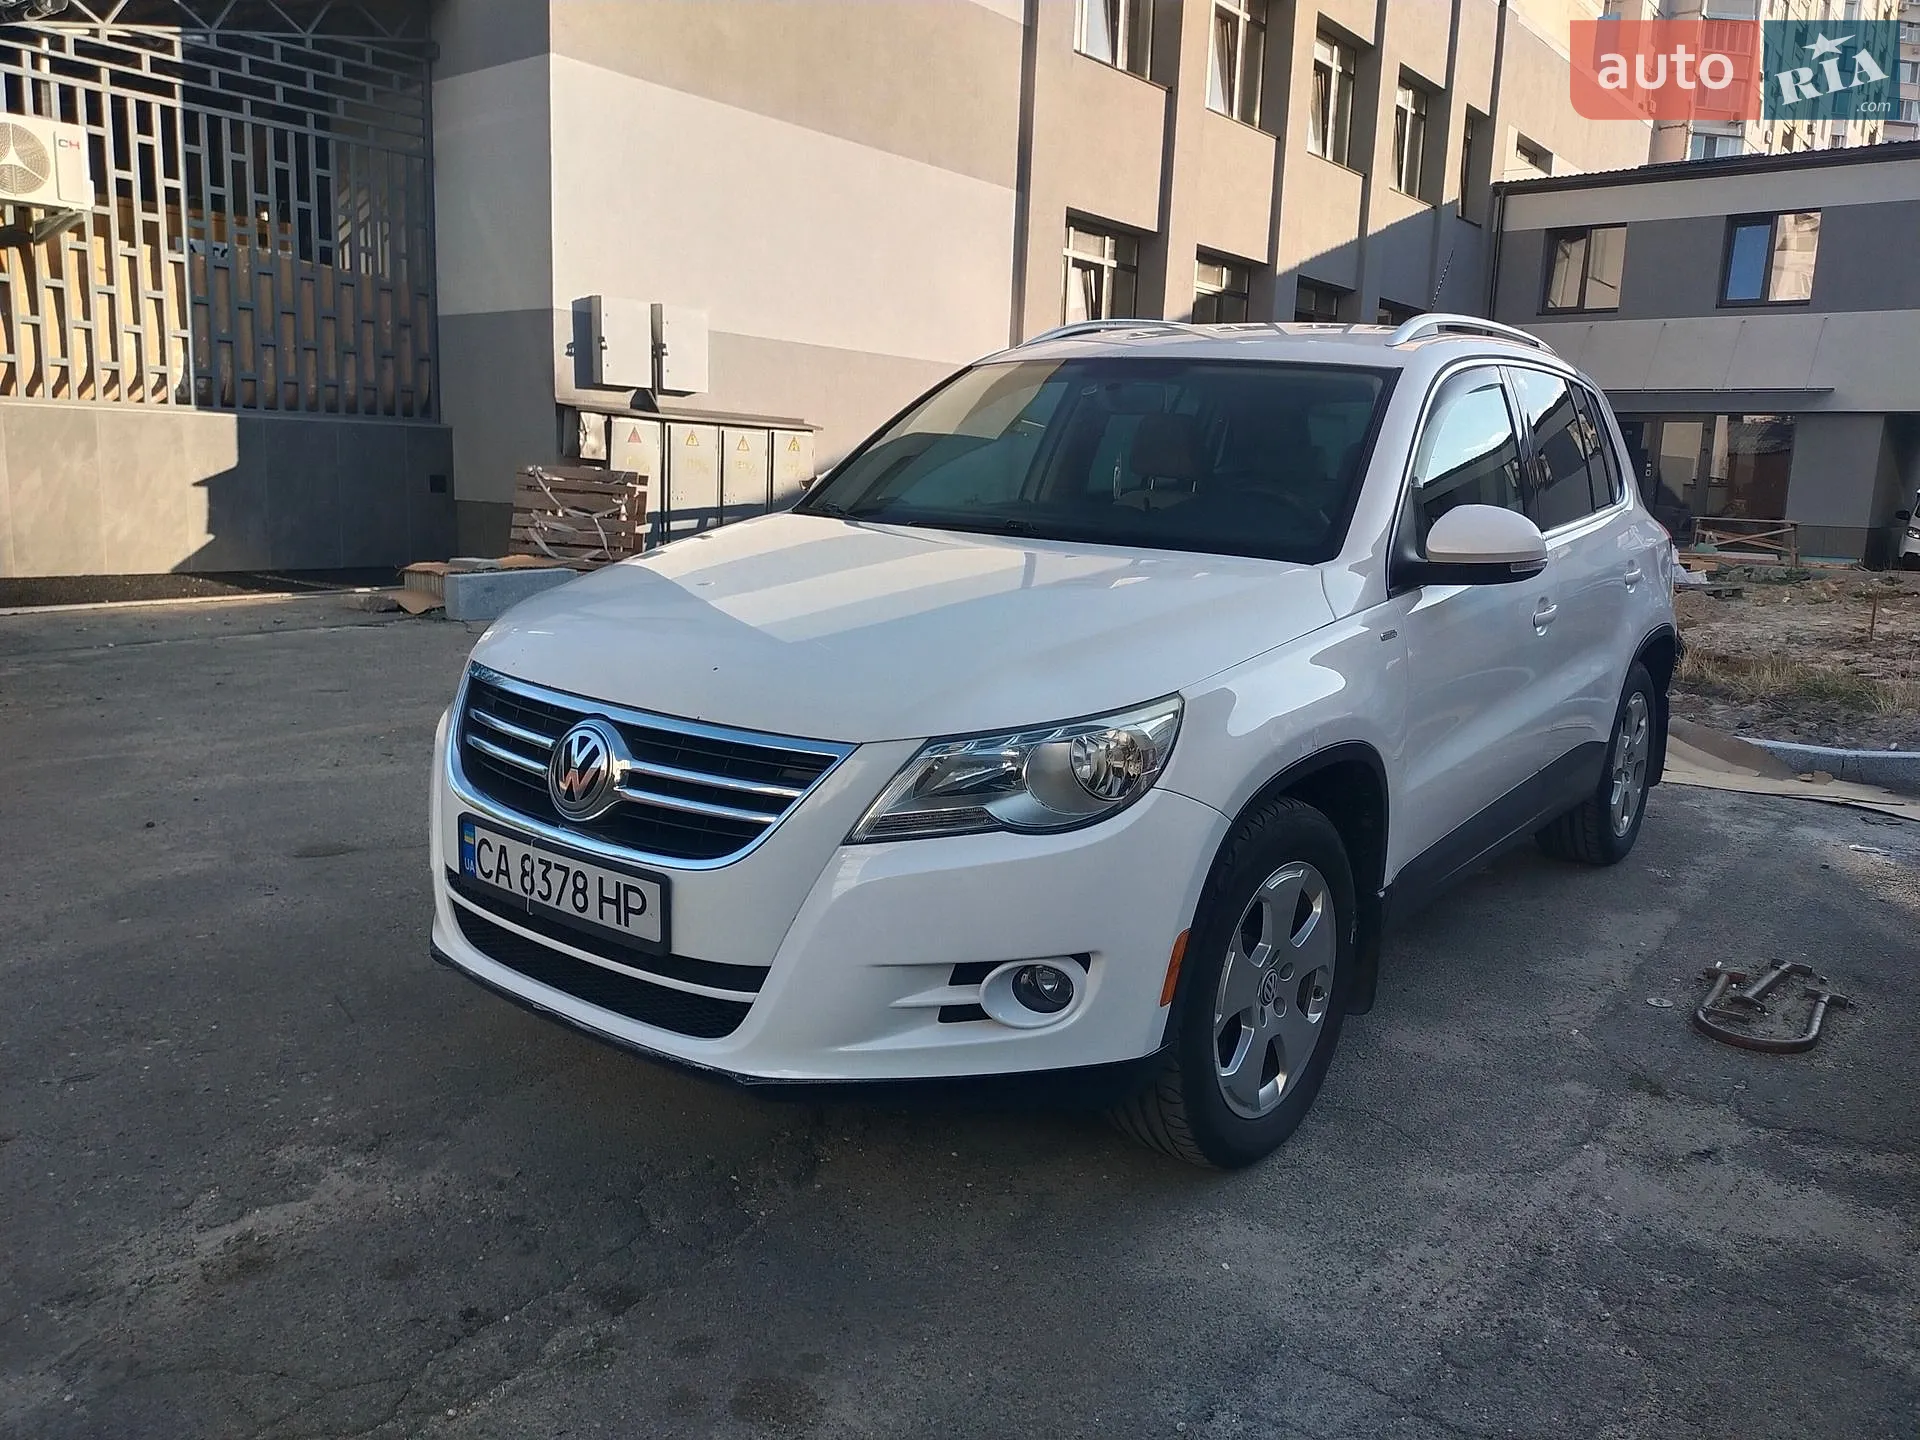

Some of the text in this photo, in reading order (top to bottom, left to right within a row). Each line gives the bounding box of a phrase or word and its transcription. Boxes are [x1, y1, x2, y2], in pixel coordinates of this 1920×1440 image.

[58, 139, 80, 150] CH
[464, 857, 476, 874] UA
[477, 838, 647, 927] CA 8378 HP
